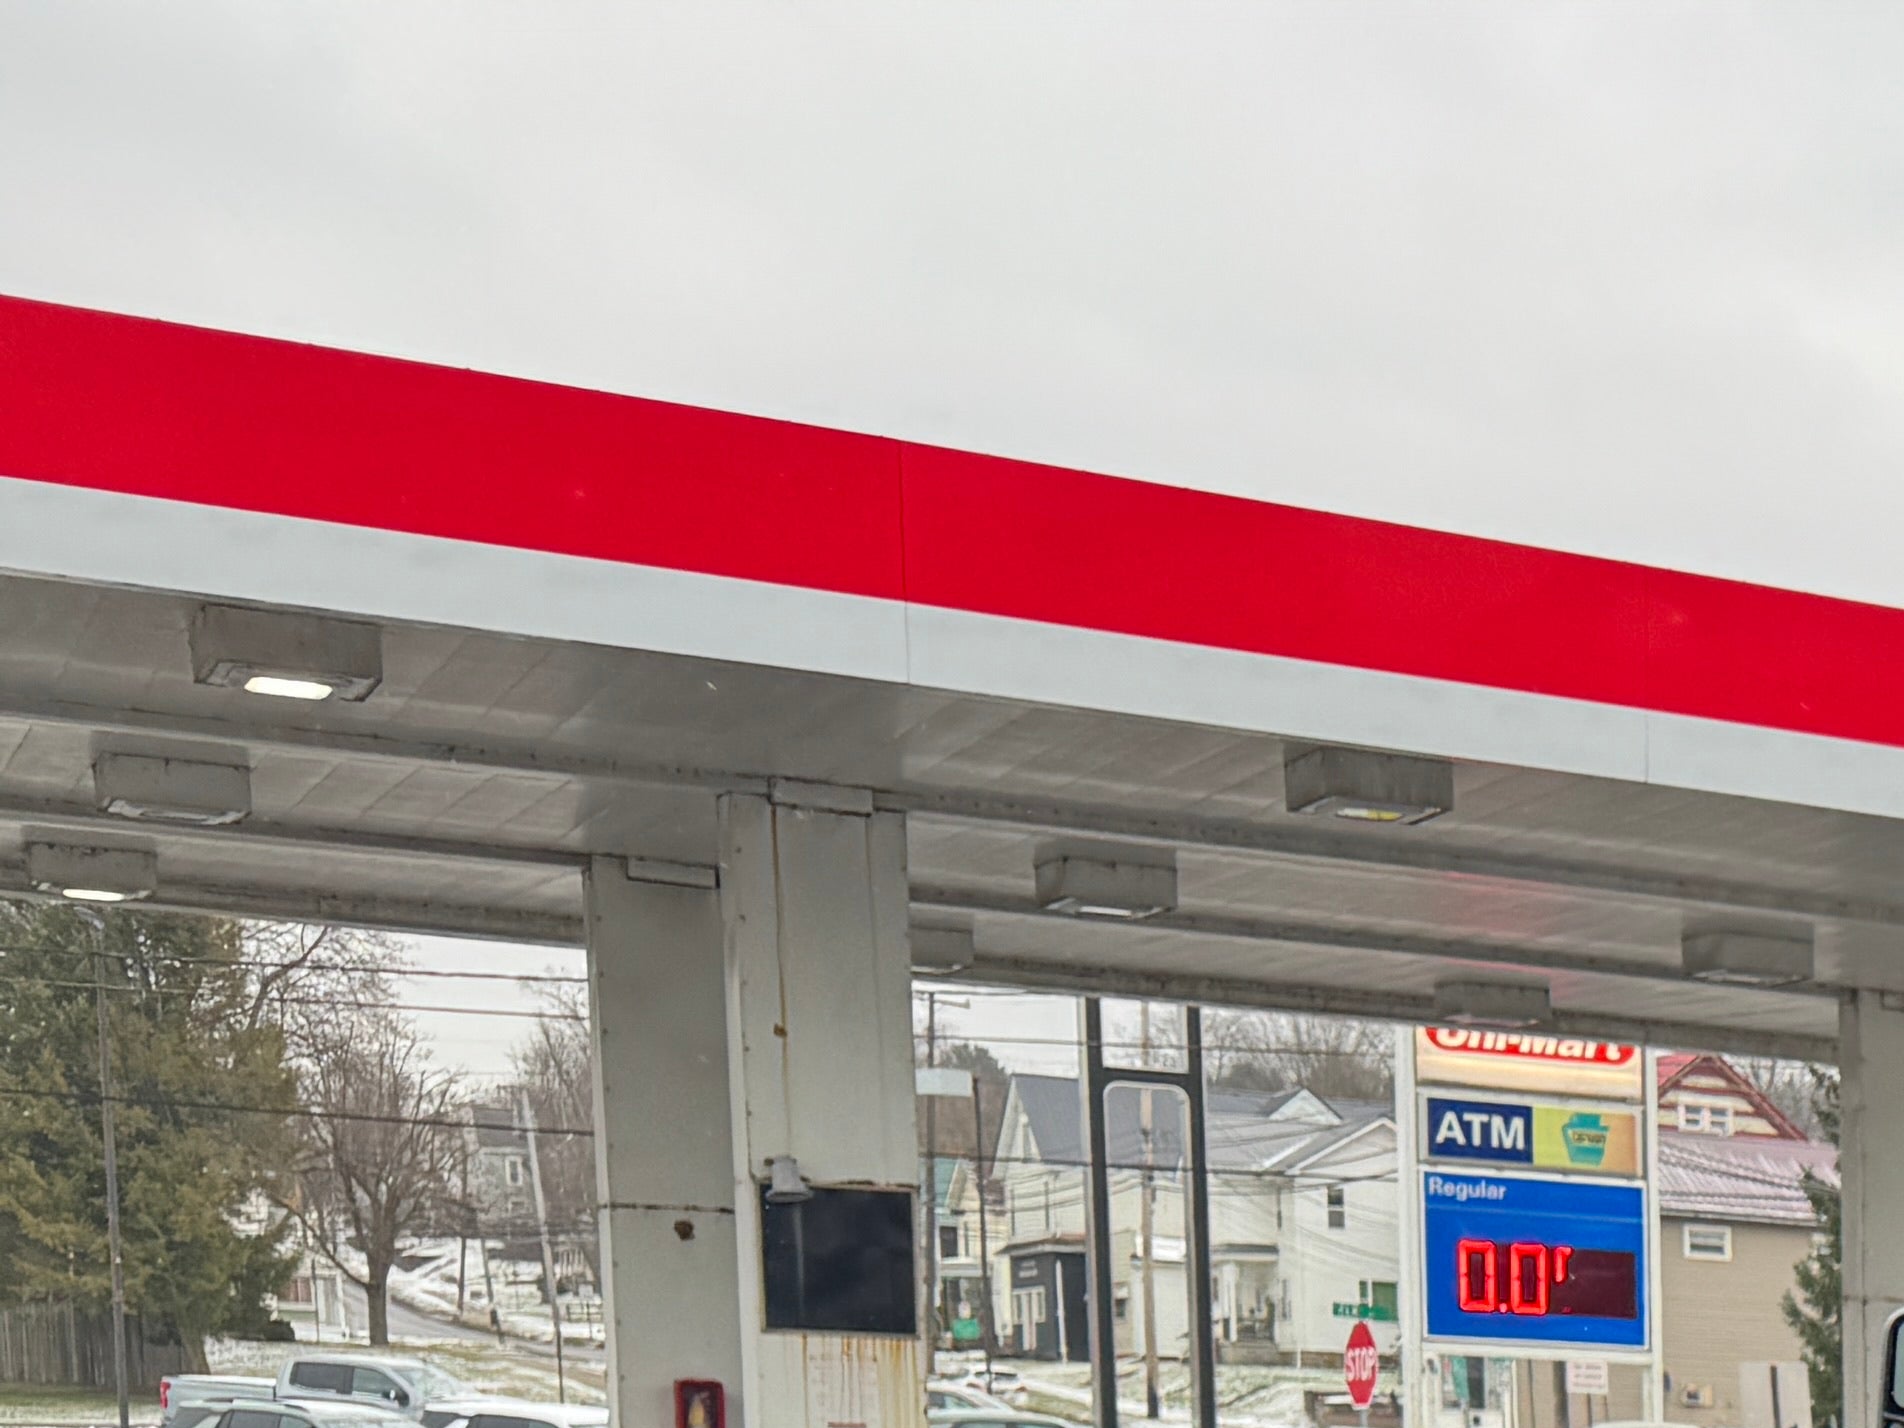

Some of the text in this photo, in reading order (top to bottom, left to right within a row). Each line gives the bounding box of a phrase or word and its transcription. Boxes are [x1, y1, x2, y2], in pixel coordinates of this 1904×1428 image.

[1435, 1111, 1526, 1151] ATM
[1428, 1176, 1507, 1202] Regular
[1346, 1346, 1376, 1382] STOP
